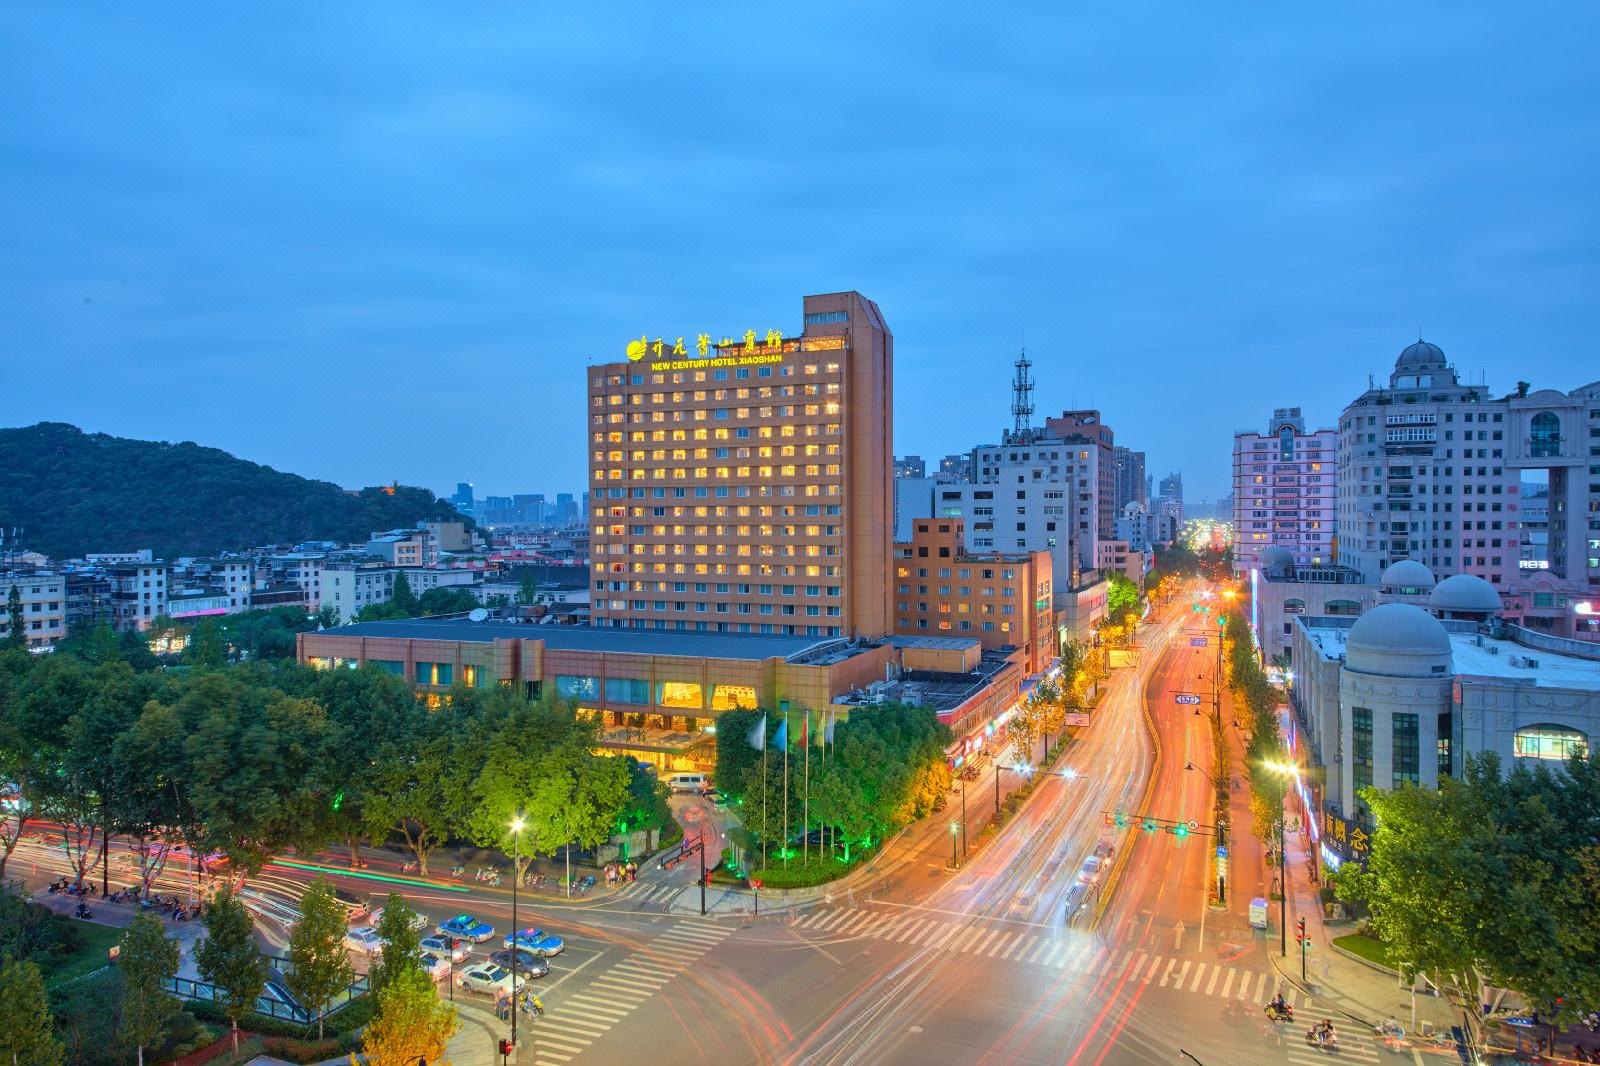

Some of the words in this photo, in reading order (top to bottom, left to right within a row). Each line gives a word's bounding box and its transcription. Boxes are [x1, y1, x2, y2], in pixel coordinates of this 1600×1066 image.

[652, 363, 670, 371] NEW
[672, 360, 710, 370] CENTURY
[711, 357, 737, 367] HOTEL
[739, 355, 782, 365] XIAOSHAN
